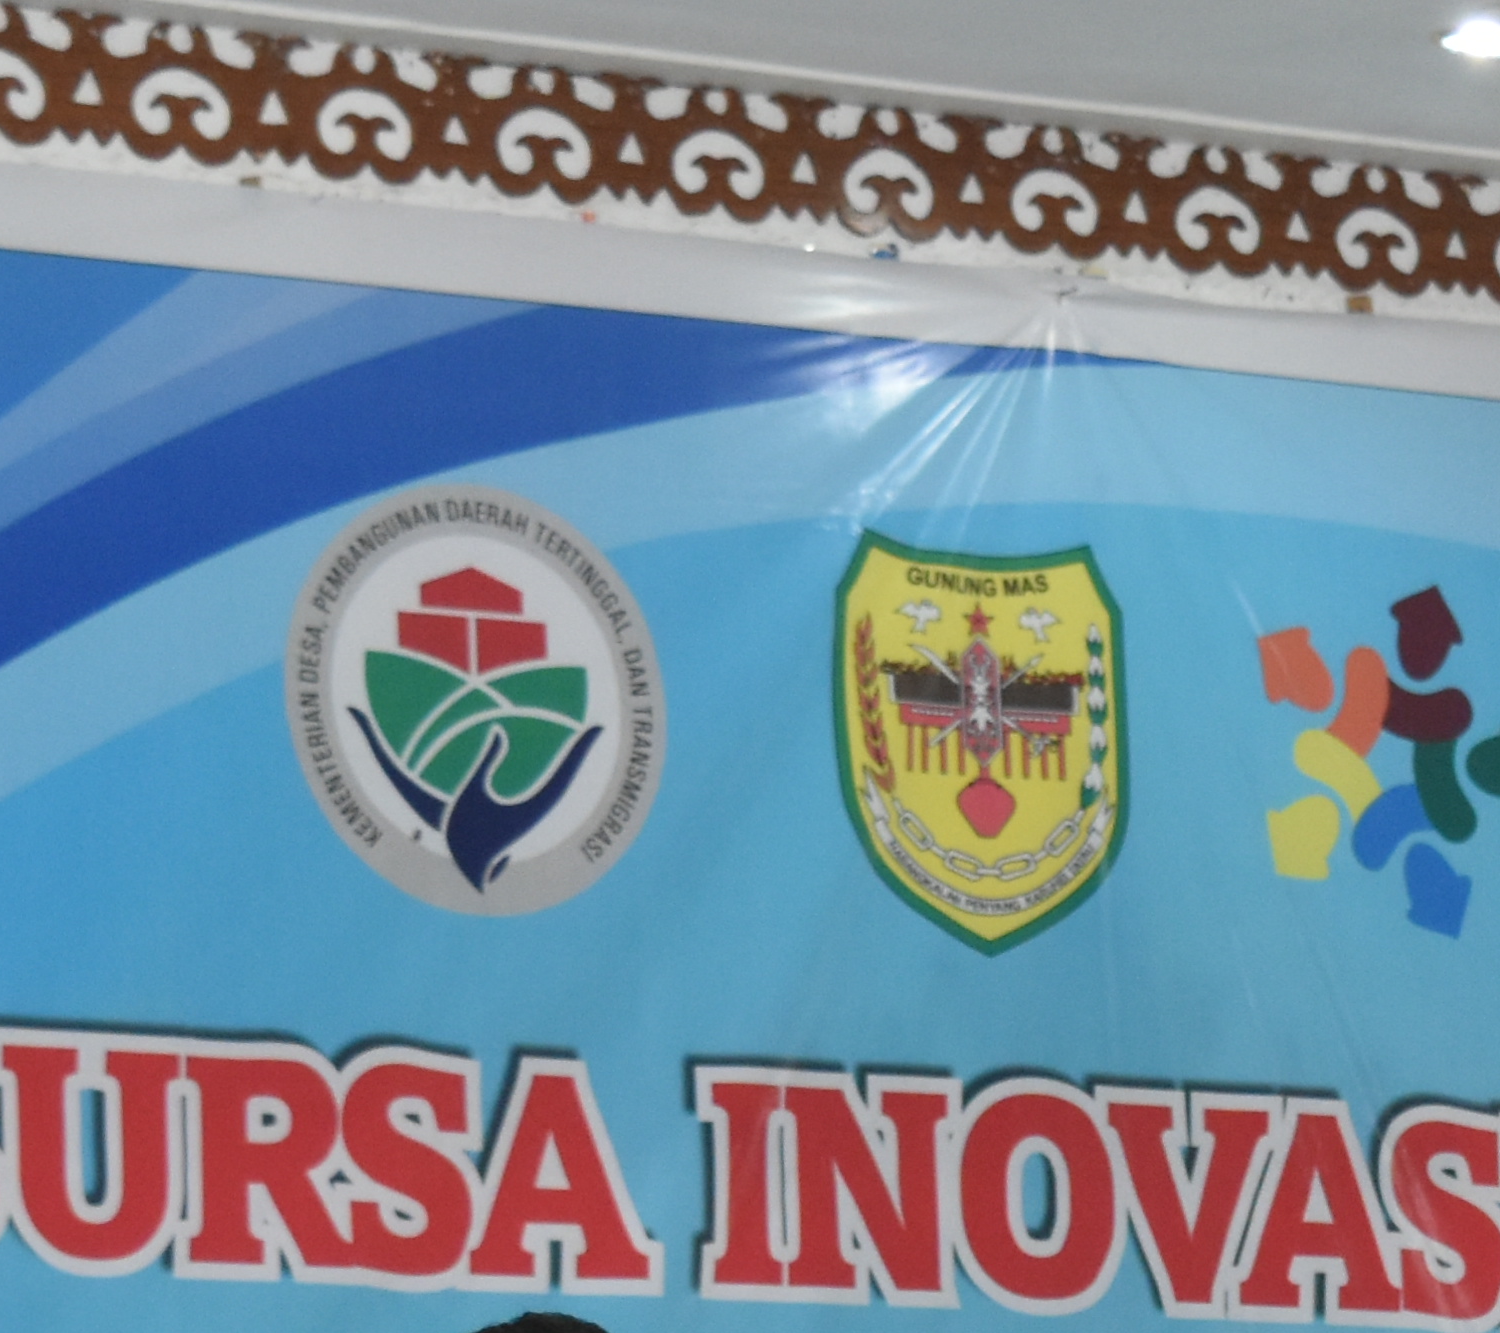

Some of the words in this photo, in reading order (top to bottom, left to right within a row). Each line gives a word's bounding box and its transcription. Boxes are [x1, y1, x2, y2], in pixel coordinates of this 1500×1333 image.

[311, 502, 440, 615] PEMBANGUNAN
[443, 498, 530, 536] DAERAH
[534, 521, 633, 645] TERTINGGAL,
[906, 565, 997, 598] GUNUNG
[1002, 573, 1049, 597] MAS
[622, 647, 650, 699] DAN
[299, 692, 384, 848] KEMENTERIAN
[580, 706, 653, 864] TRANSMIGRASI
